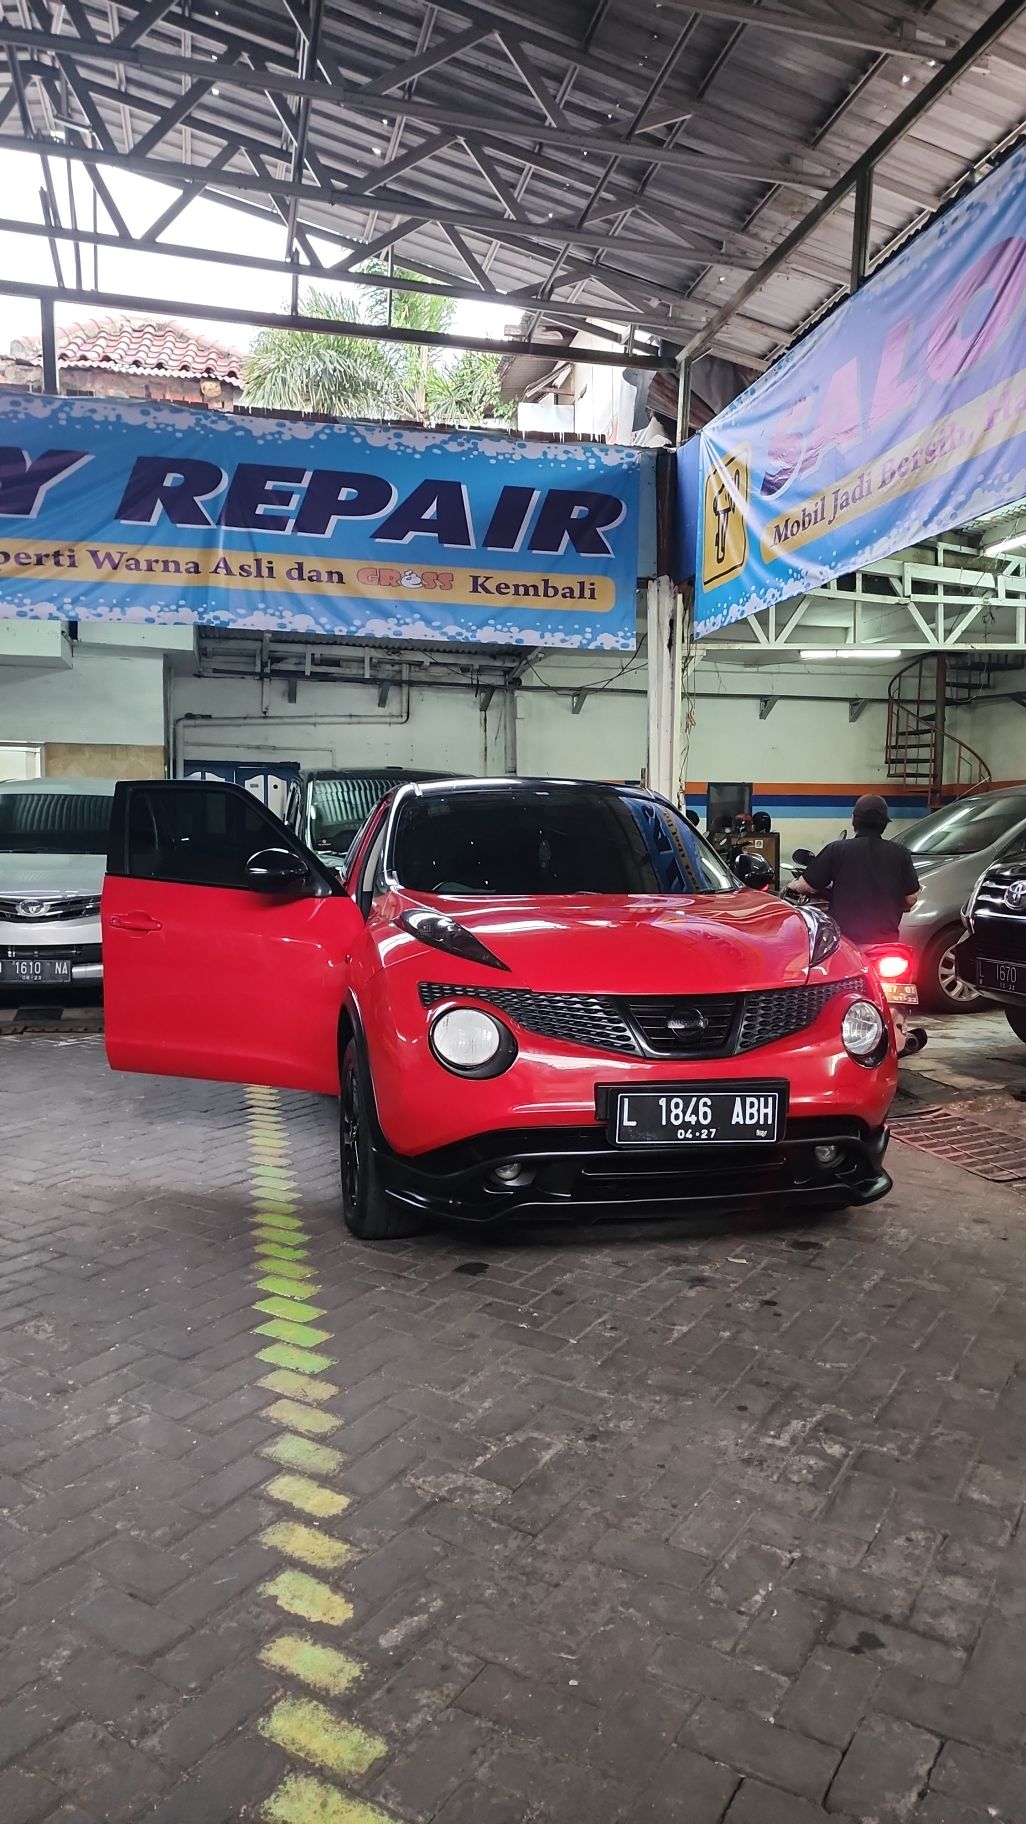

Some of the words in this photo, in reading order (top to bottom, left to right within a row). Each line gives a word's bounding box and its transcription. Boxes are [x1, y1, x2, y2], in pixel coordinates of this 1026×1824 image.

[0, 446, 95, 519] Y
[114, 456, 627, 559] REPAIR
[771, 494, 826, 546] Mobil
[828, 470, 873, 525] Jadi
[86, 549, 201, 575] Warna
[209, 556, 277, 579] Asli
[286, 561, 346, 584] dan
[469, 575, 598, 600] Kembali
[15, 961, 41, 974] 1610
[55, 961, 68, 974] NA
[996, 964, 1017, 983] 1670
[623, 1098, 637, 1126] L
[658, 1097, 712, 1126] 1846
[731, 1096, 773, 1125] ABH
